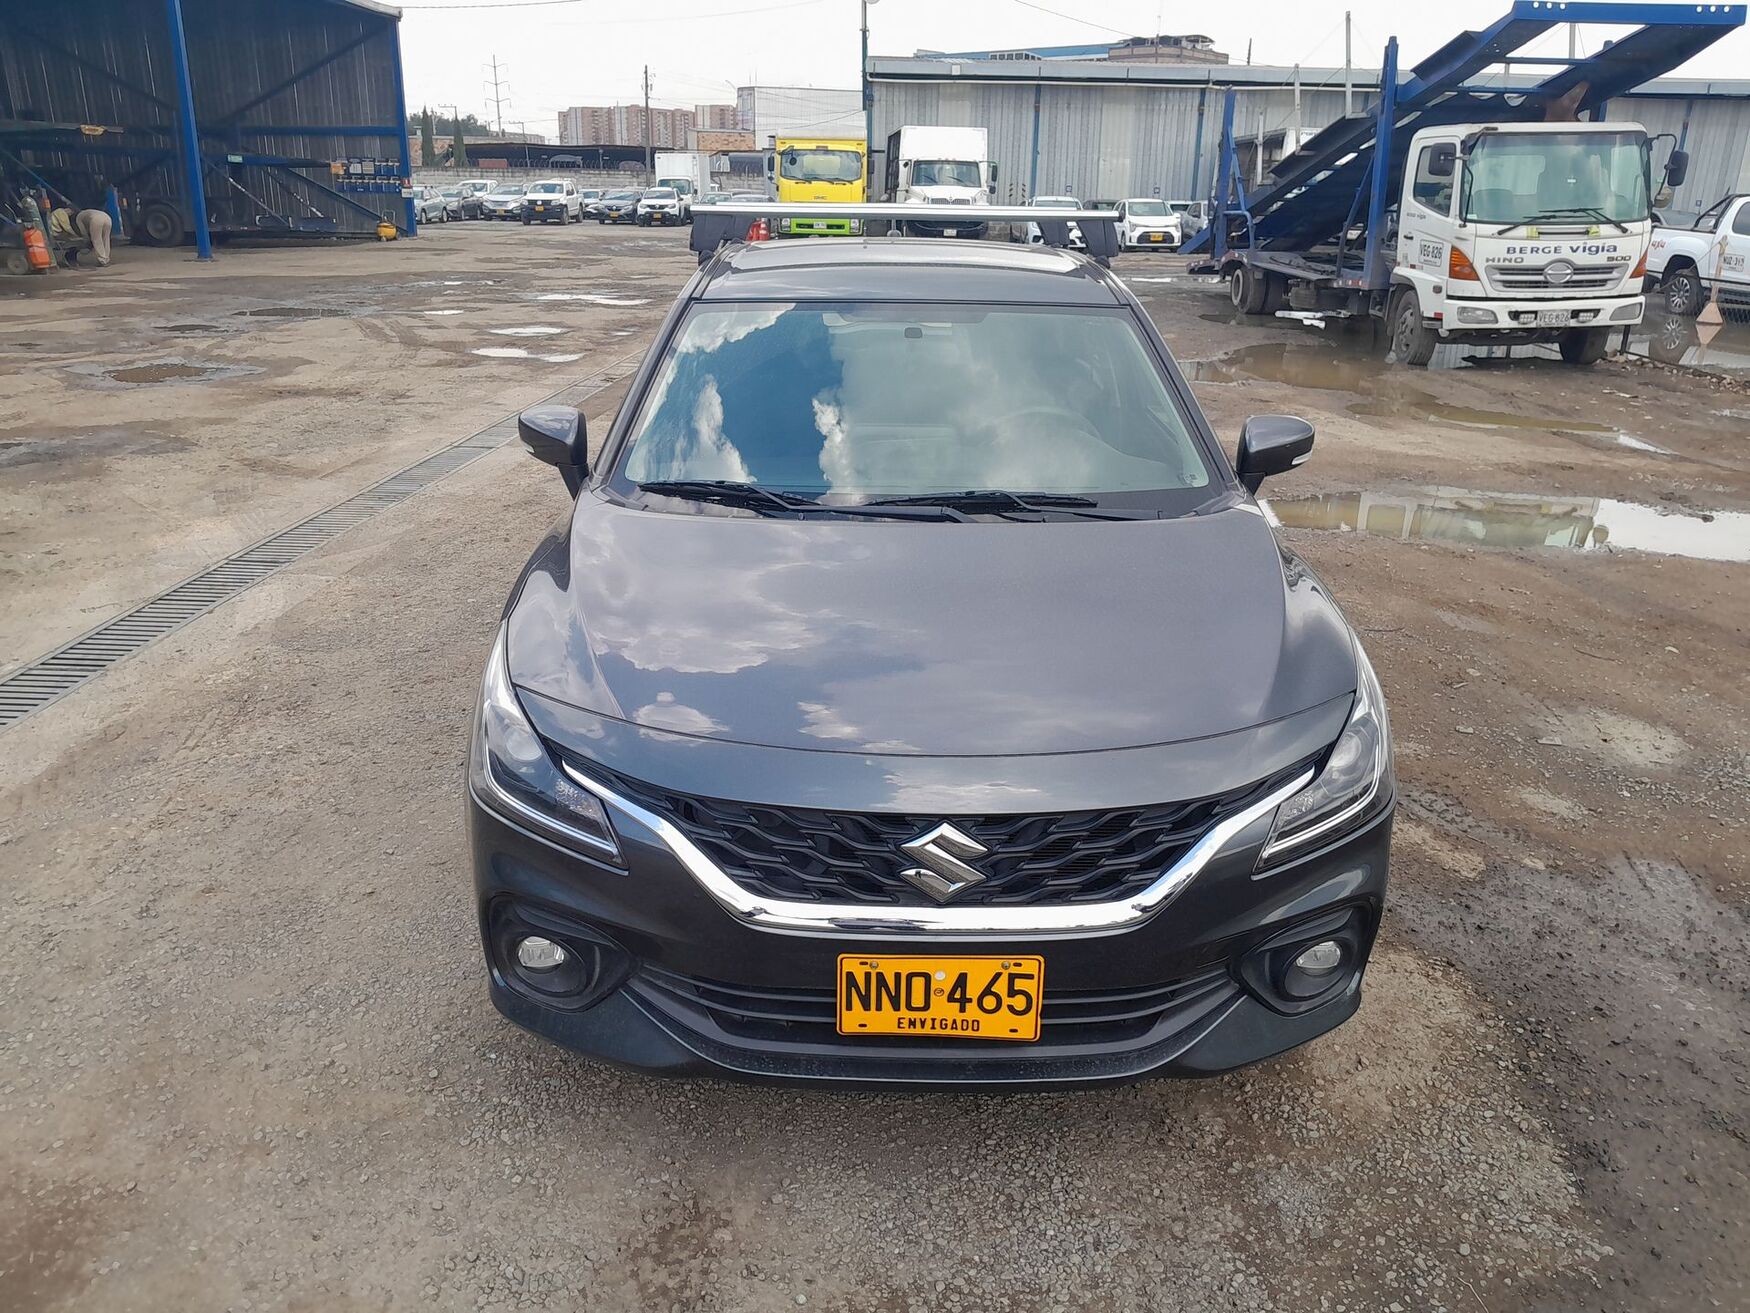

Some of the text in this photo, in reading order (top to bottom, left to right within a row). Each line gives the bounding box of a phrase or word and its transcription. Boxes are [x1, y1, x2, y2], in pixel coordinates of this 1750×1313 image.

[1485, 256, 1524, 264] HINO
[845, 971, 1035, 1016] NNO 465
[897, 1017, 980, 1032] ENVIGADO
